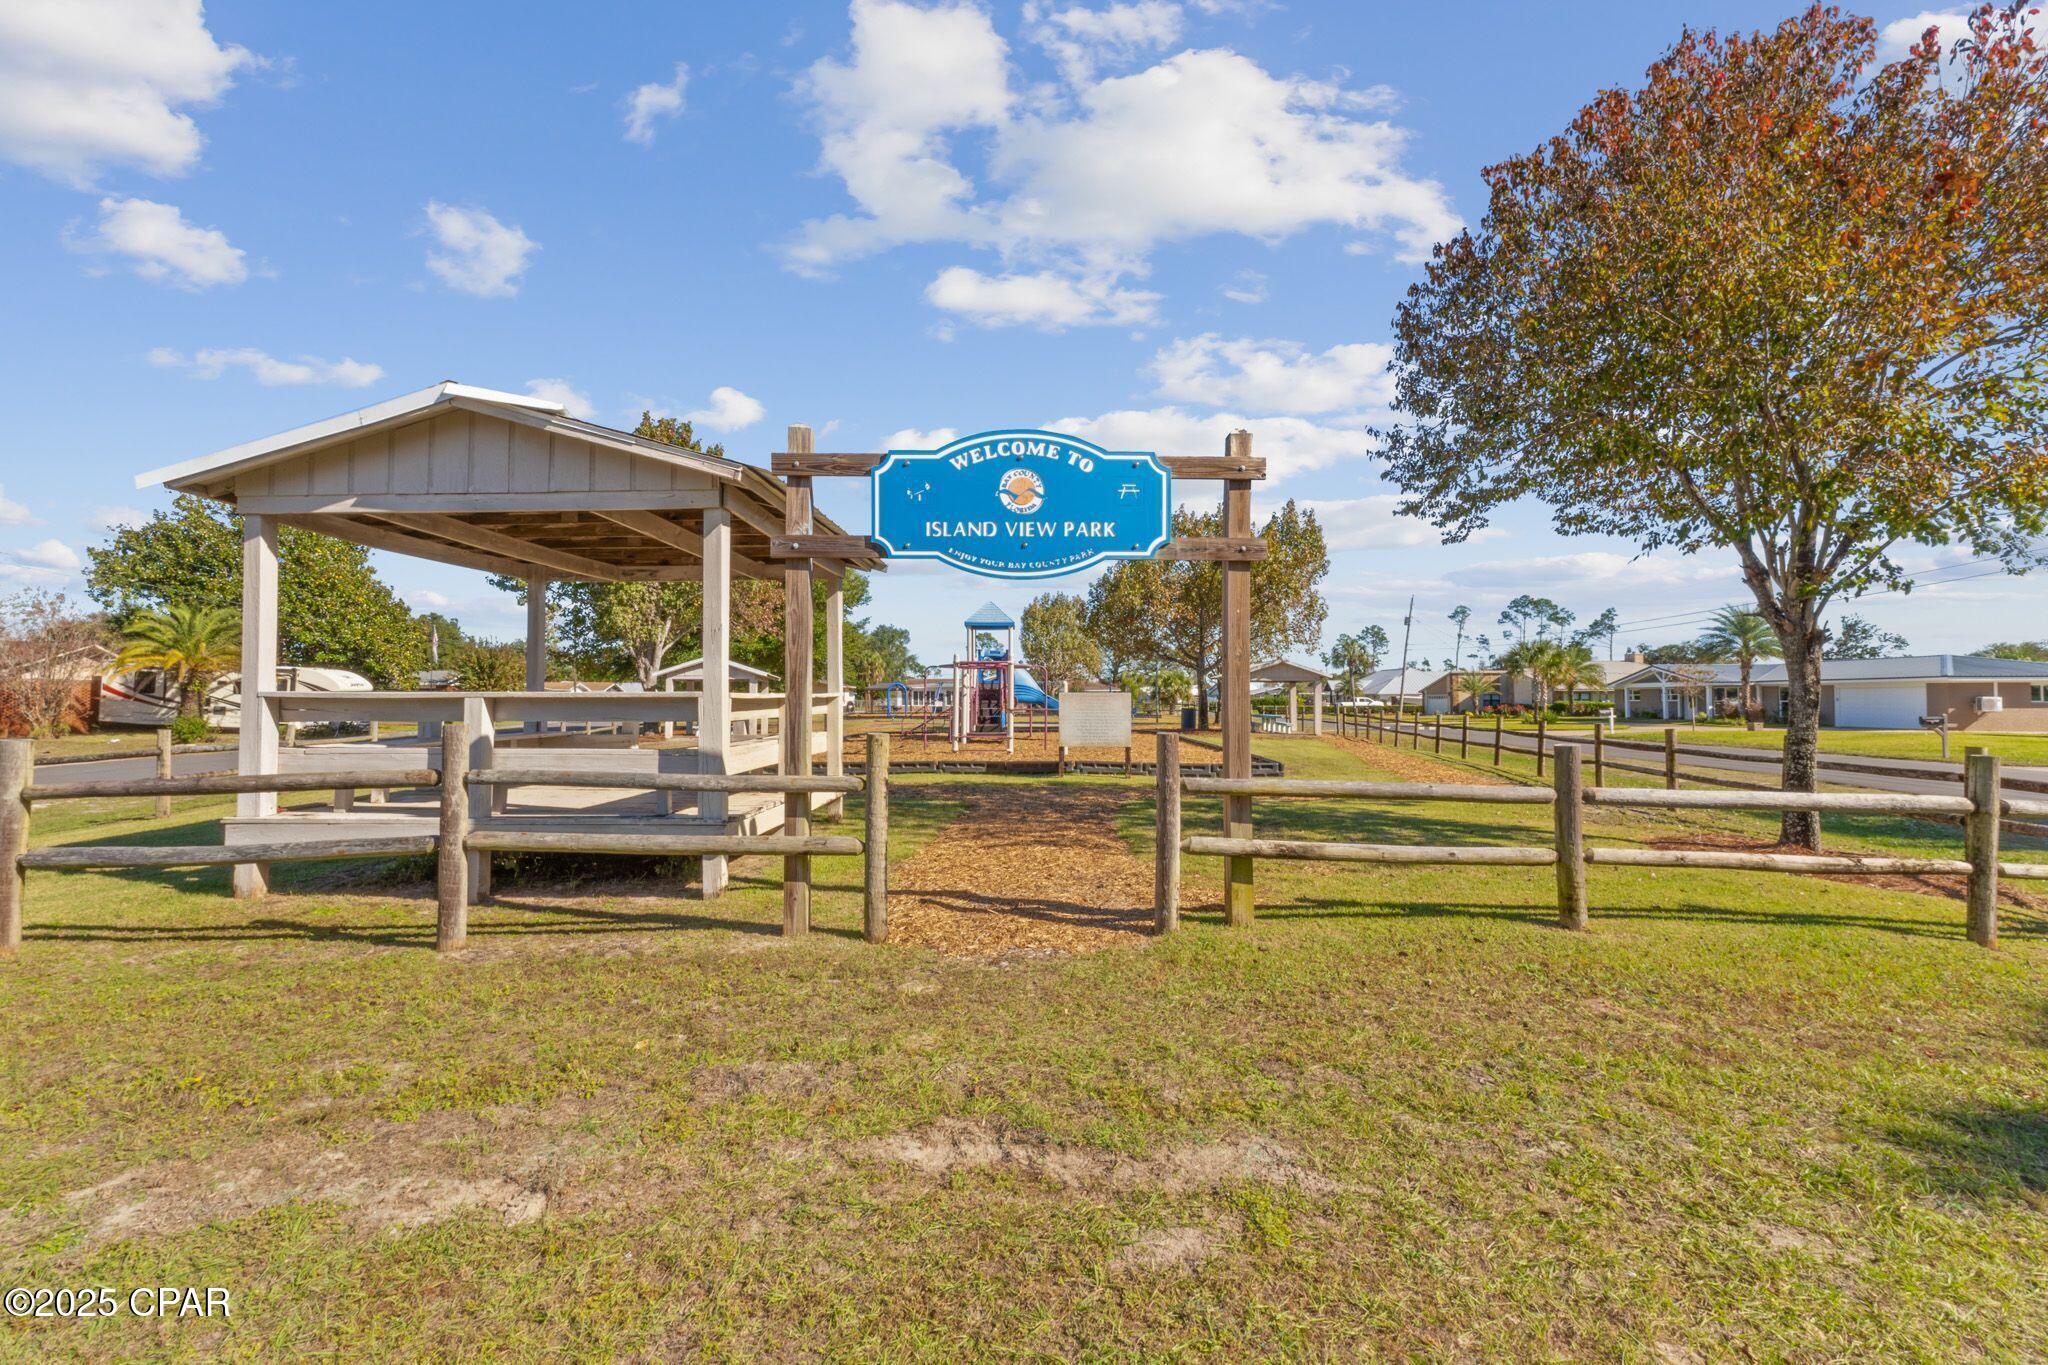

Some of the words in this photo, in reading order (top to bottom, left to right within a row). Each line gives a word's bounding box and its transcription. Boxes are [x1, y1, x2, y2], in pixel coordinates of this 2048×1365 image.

[949, 441, 1060, 471] WELCOME
[1068, 450, 1094, 473] TO
[1001, 474, 1013, 489] BAY
[1013, 470, 1042, 489] COUNTY
[925, 521, 997, 538] ISLAND
[1005, 521, 1057, 538] VIEW
[1063, 521, 1116, 538] PARK
[948, 547, 977, 562] ENJOY
[980, 556, 1005, 568] YOUR
[1008, 561, 1026, 569] BAY
[1029, 556, 1067, 569] COUNTY
[1069, 548, 1095, 563] PARK
